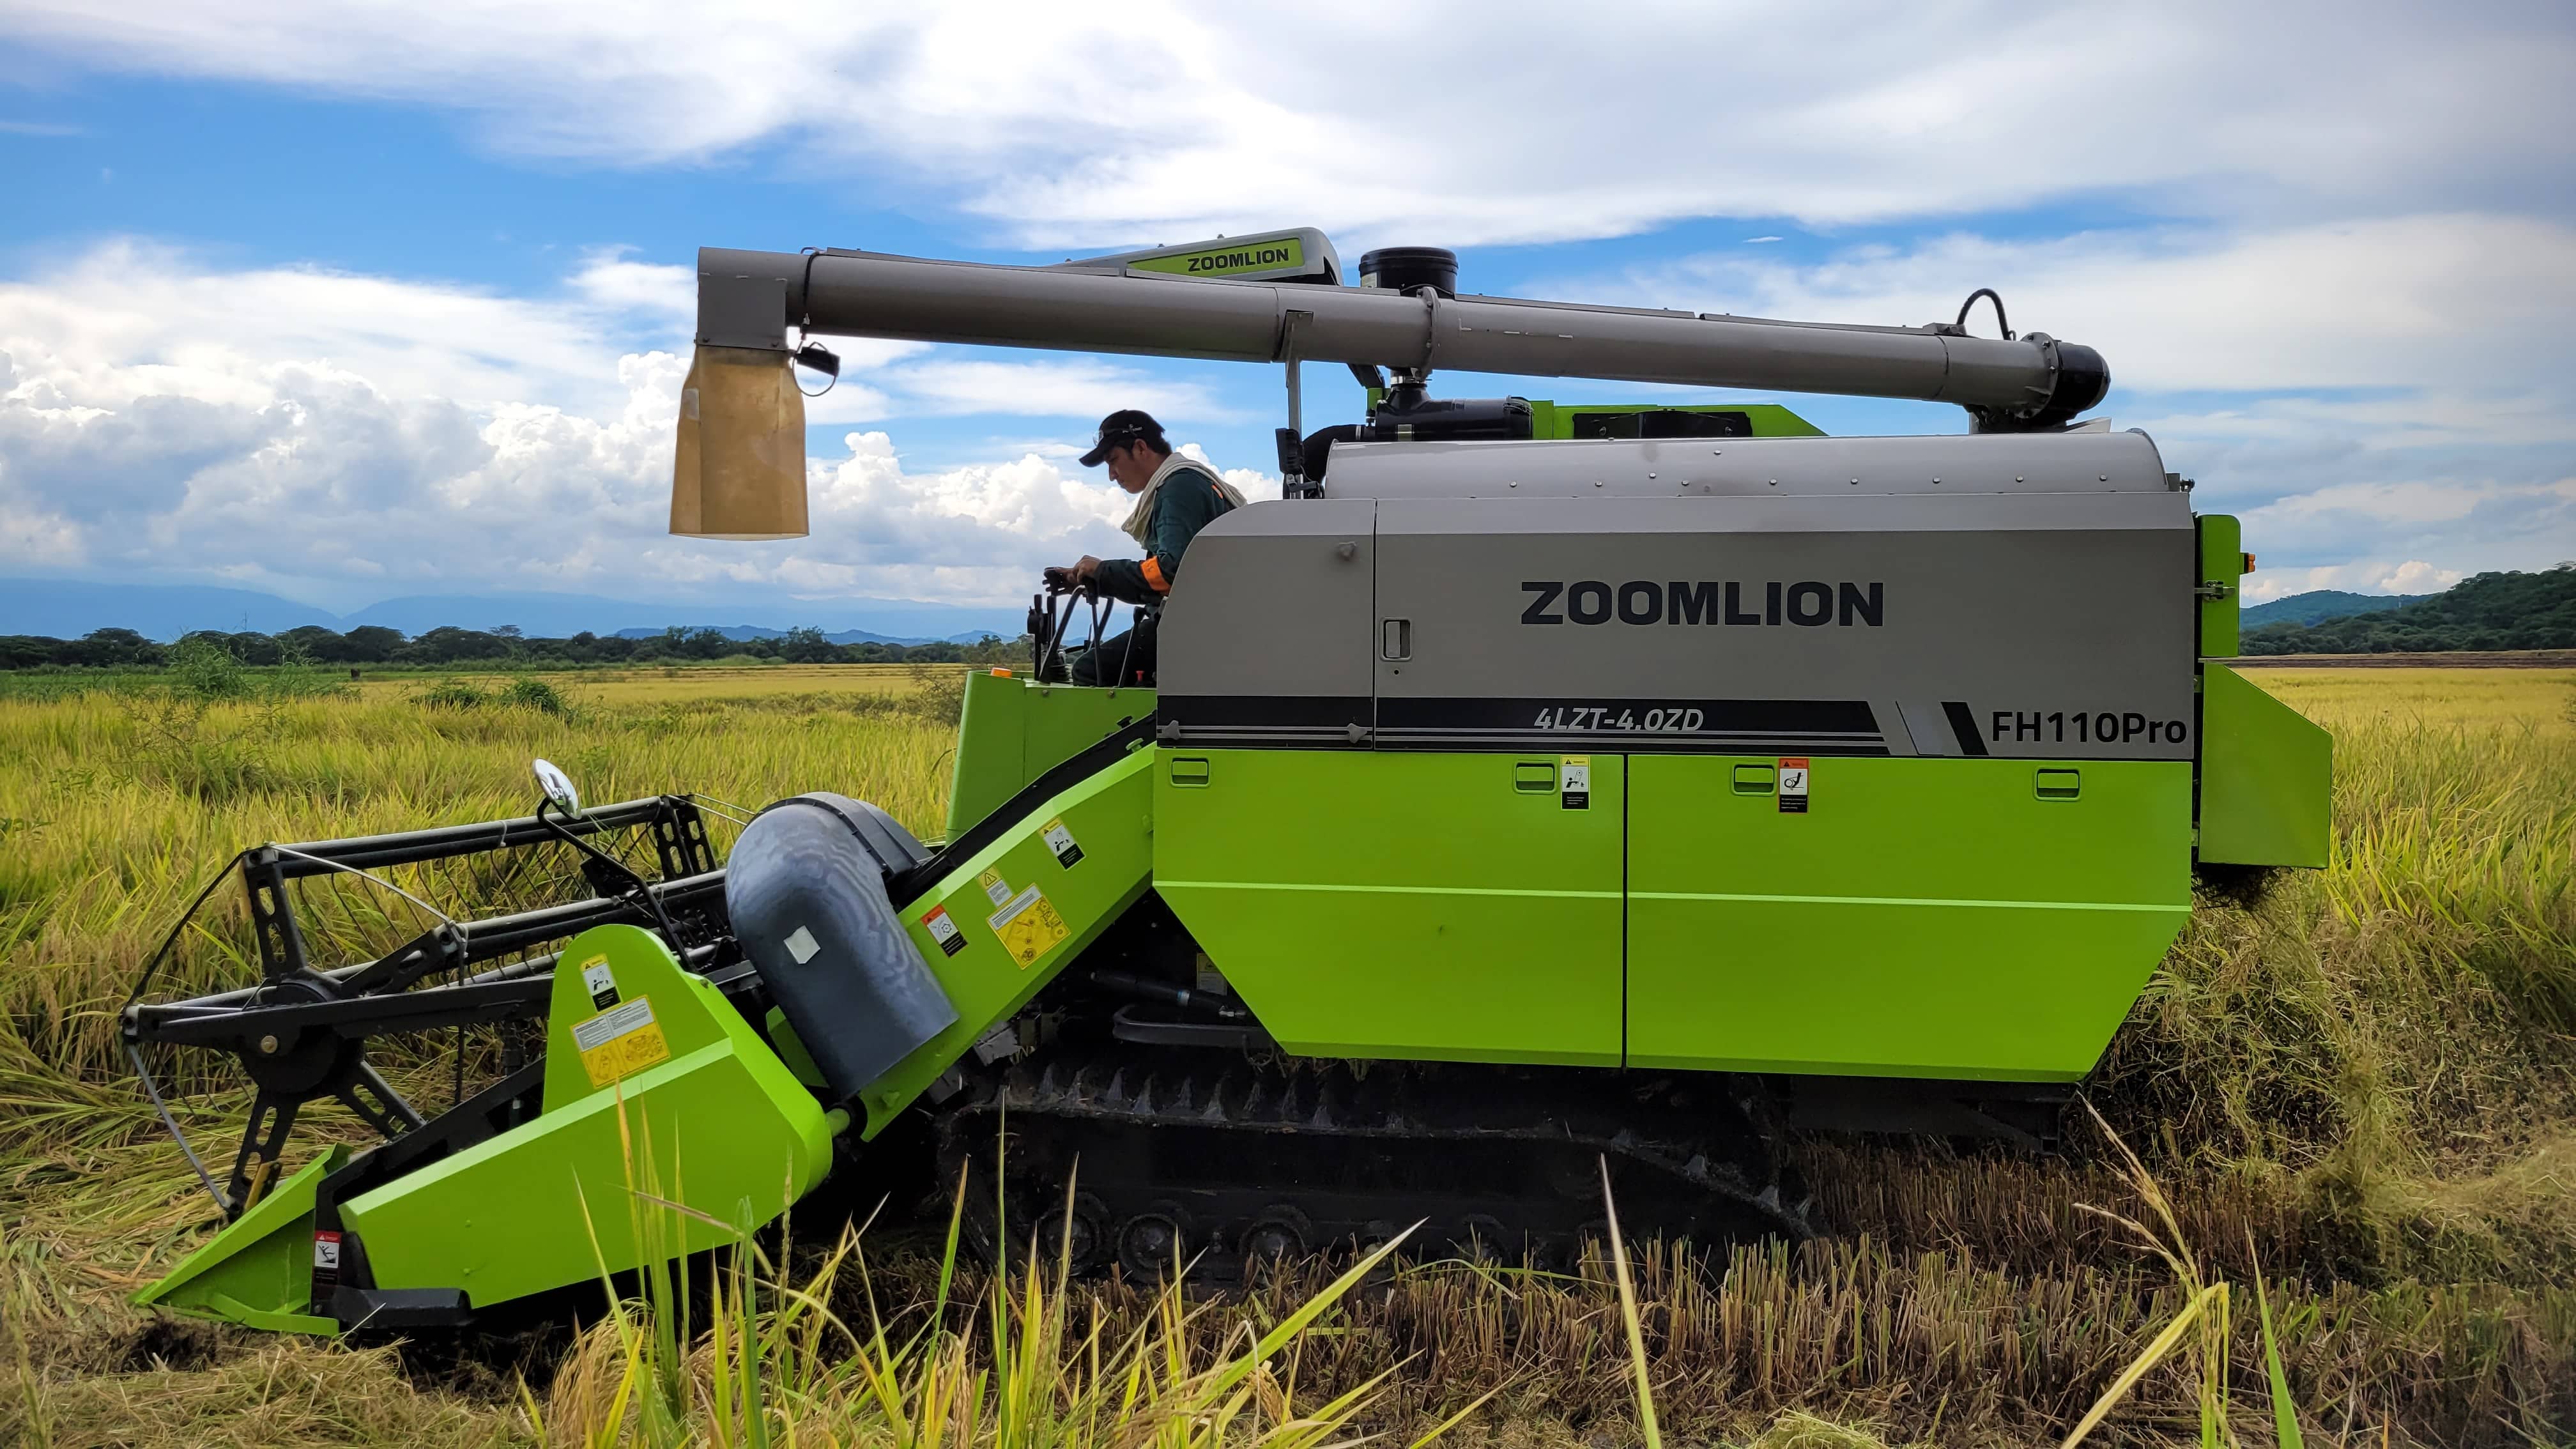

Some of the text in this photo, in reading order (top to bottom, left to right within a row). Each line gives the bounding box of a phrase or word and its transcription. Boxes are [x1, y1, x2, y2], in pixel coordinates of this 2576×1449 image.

[1187, 248, 1289, 272] ZOOMLION
[1521, 580, 1884, 627] ZOOMLION
[1533, 707, 1705, 732] 4LZT-4.0ZD
[1992, 711, 2188, 744] FH110Pro
